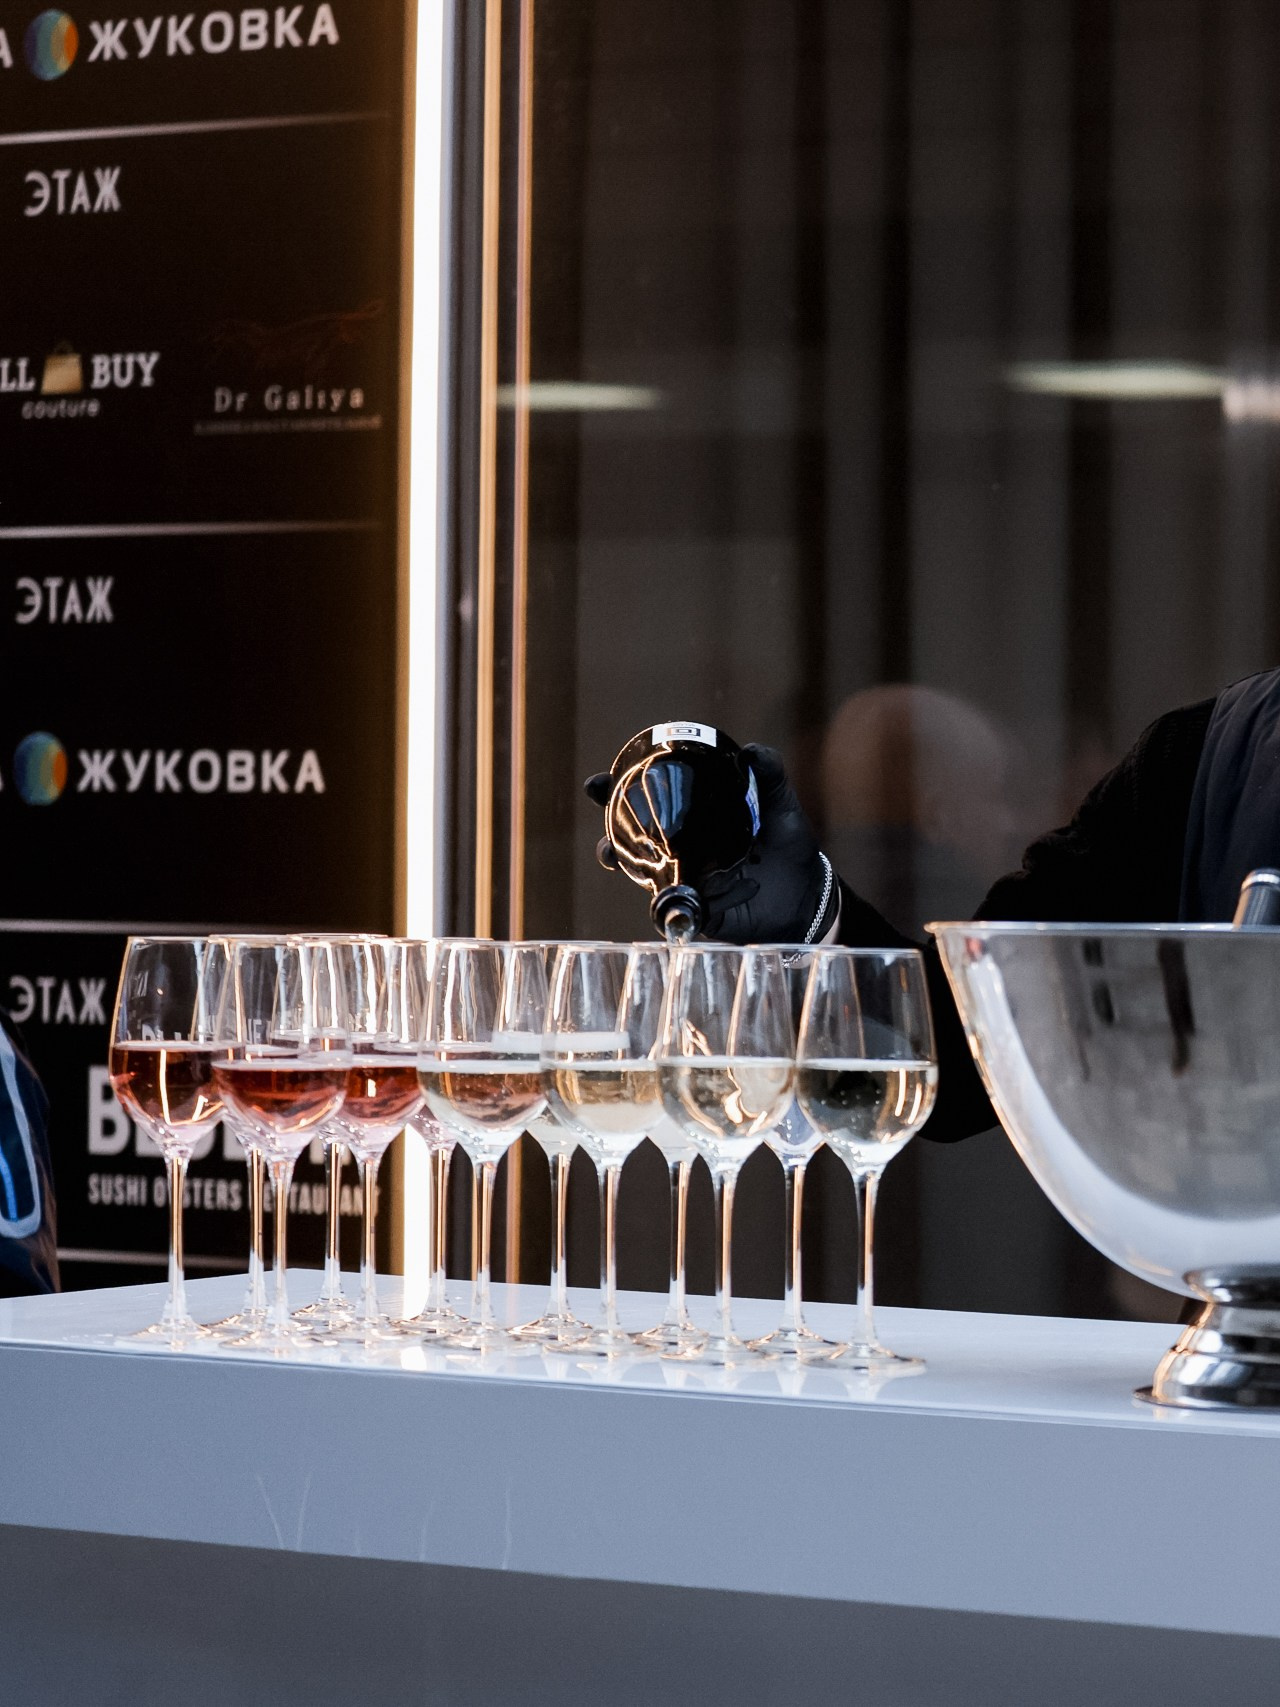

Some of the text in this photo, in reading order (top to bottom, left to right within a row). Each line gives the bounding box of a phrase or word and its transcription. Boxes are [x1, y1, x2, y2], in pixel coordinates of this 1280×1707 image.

[88, 3, 341, 62] ЖУКОВКА
[23, 166, 122, 217] ЭТАЖ
[91, 352, 160, 388] BUY
[214, 386, 248, 413] Dr
[15, 576, 115, 625] ЭТАЖ
[76, 749, 326, 794] ЖУКОВКА
[9, 975, 106, 1025] ЭТАЖ
[88, 1173, 148, 1206] SUSHI
[153, 1176, 242, 1212] OSTERS
